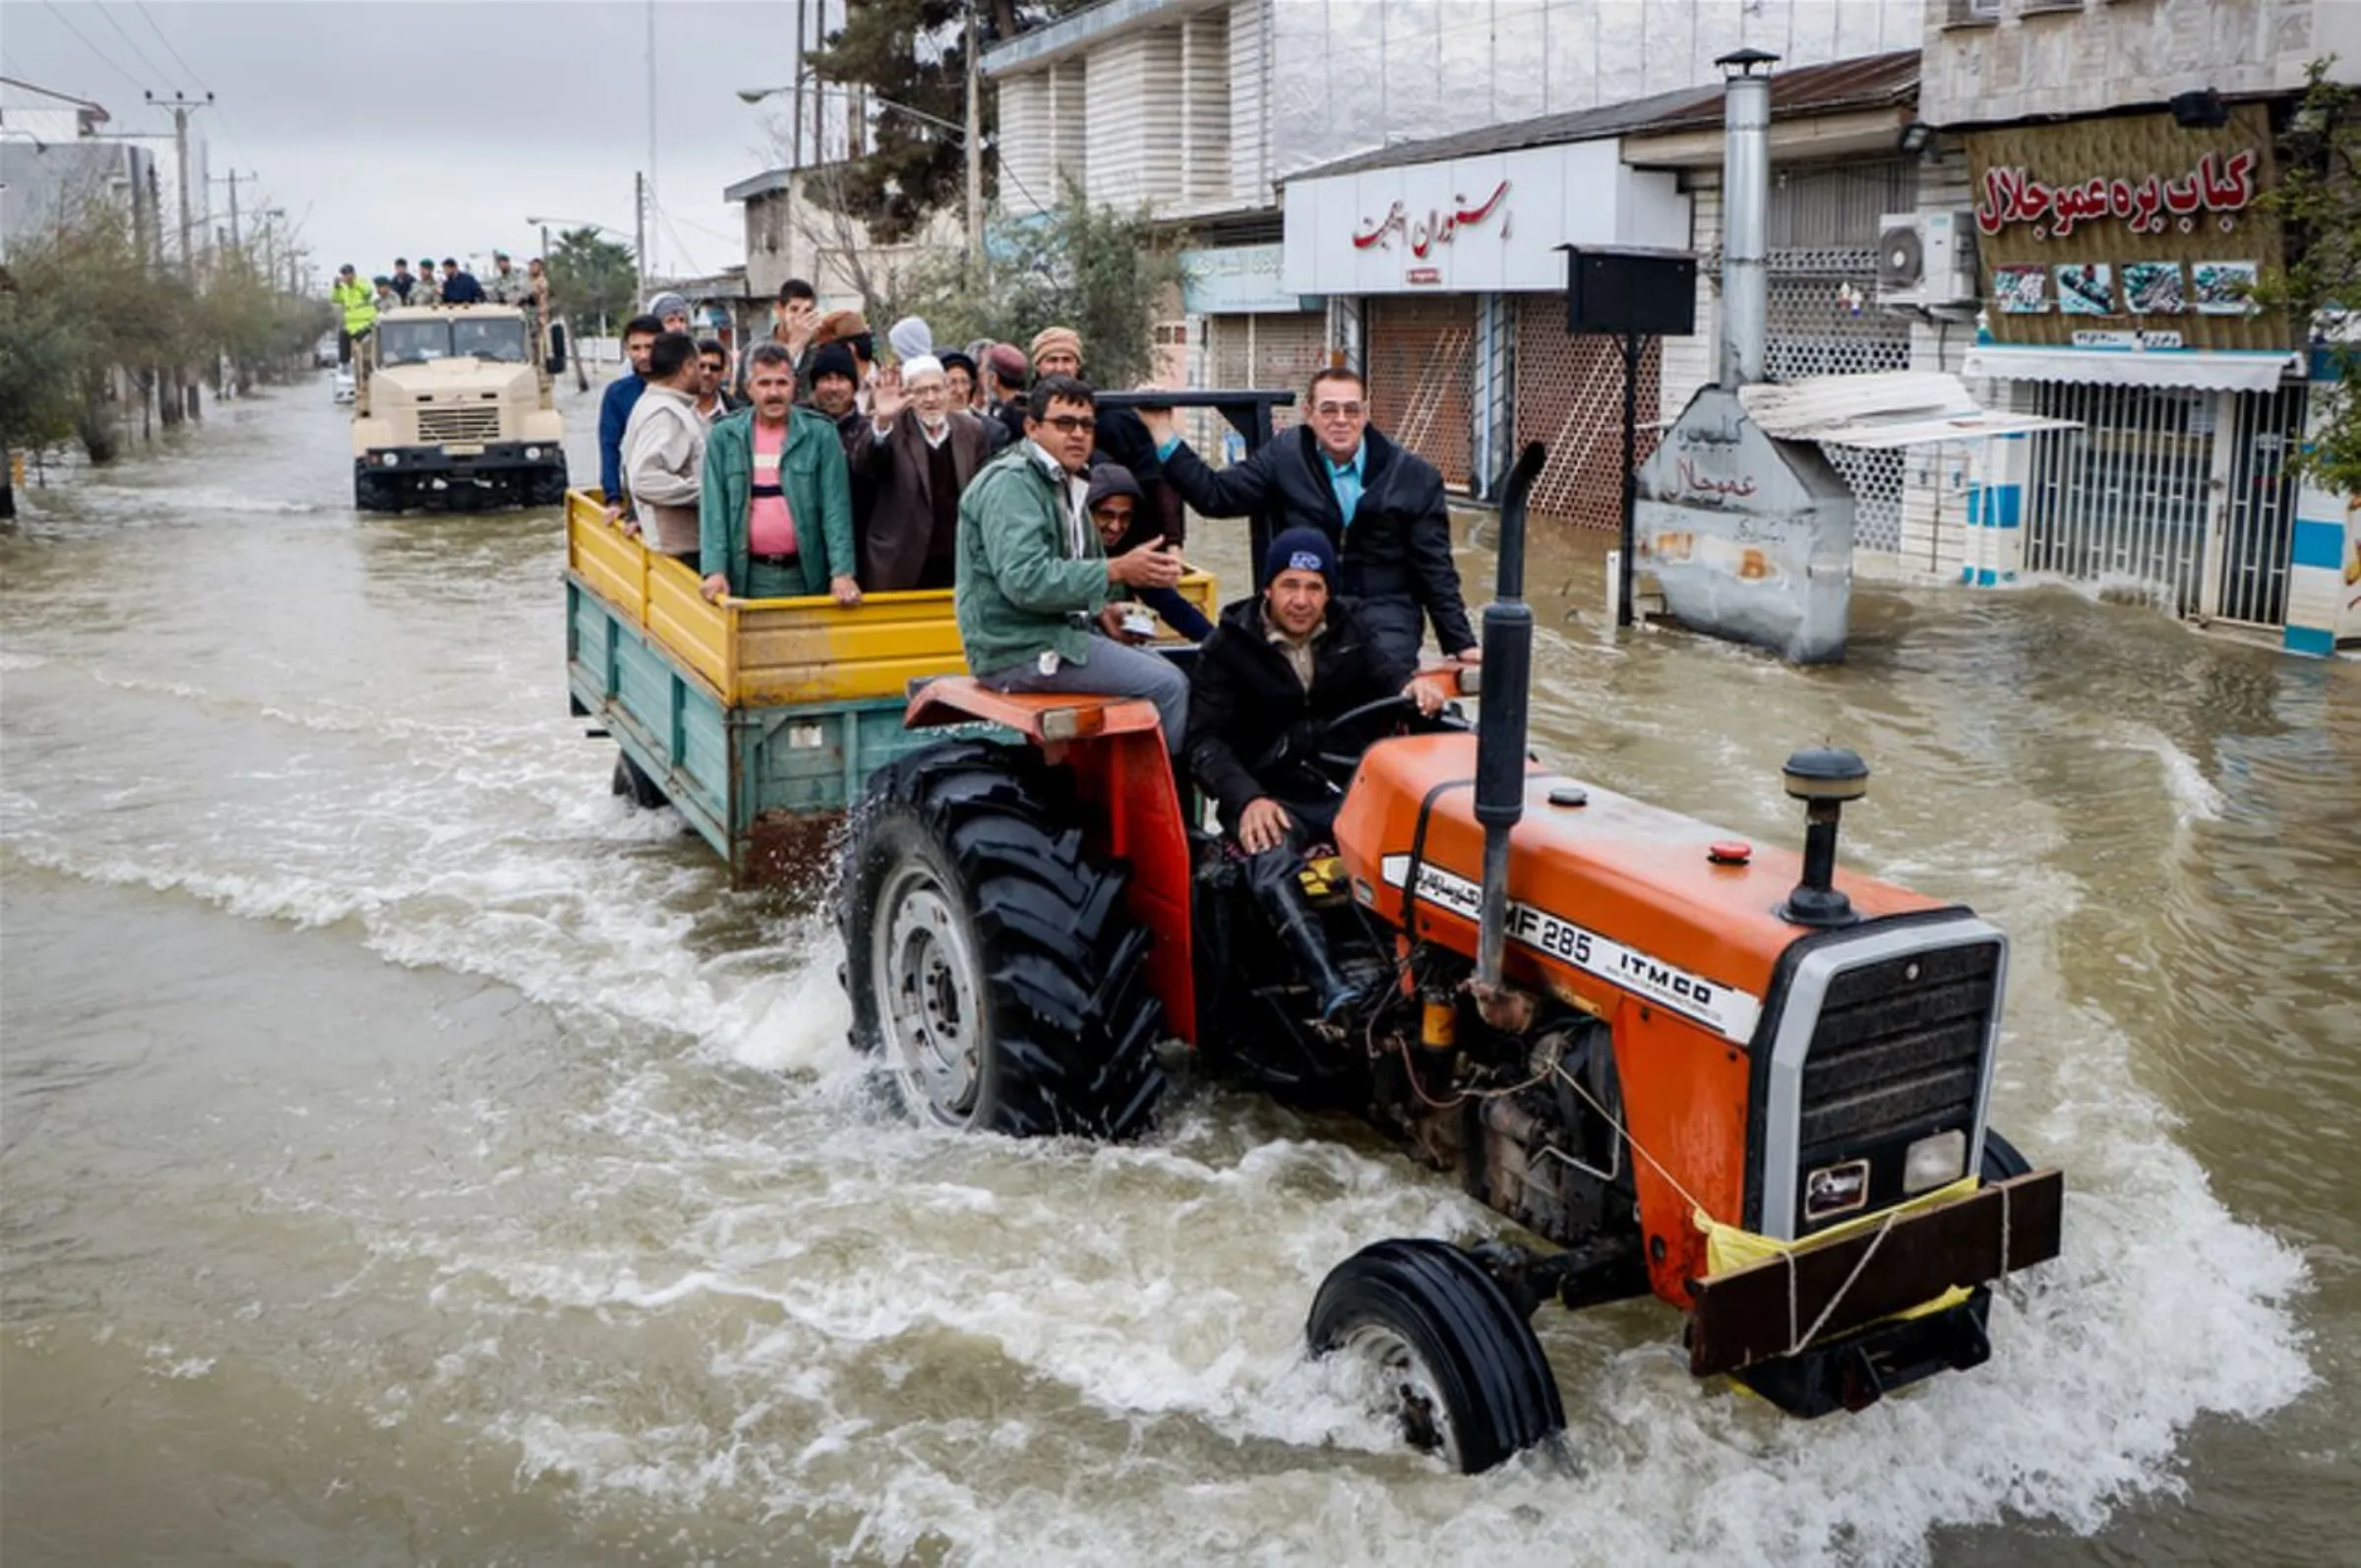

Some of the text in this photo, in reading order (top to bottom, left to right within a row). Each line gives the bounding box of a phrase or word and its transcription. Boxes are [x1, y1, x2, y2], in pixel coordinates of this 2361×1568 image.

[1412, 179, 1513, 259] رستوران
[2111, 174, 2163, 233] بره
[2164, 149, 2255, 234] کباب
[1504, 904, 1539, 935] MF
[1541, 919, 1593, 964] 285
[1618, 951, 1712, 1005] ITMCO
